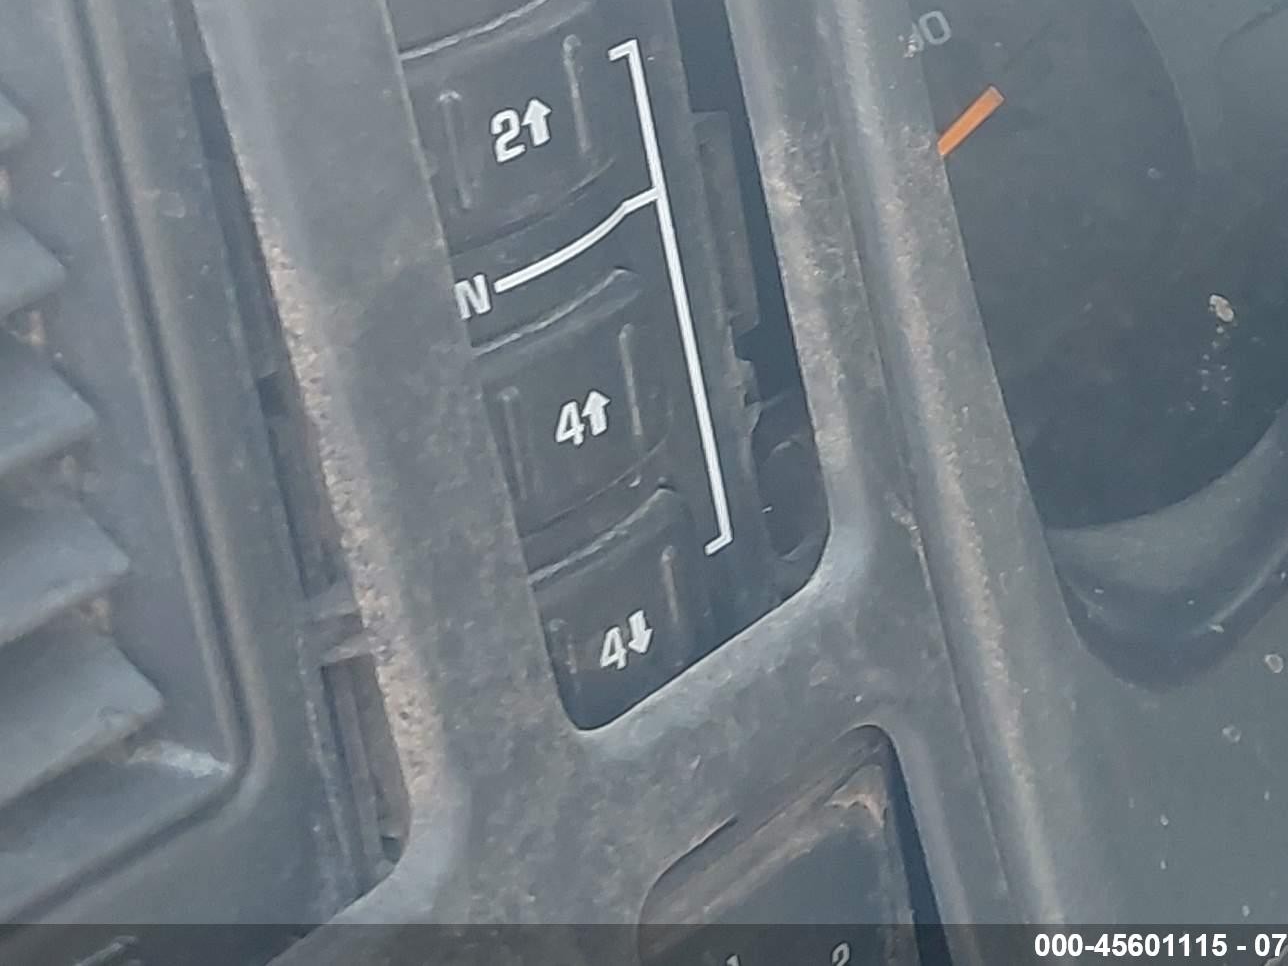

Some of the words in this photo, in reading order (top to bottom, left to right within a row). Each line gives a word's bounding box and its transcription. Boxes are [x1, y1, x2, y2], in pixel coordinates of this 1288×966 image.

[491, 111, 525, 163] 2
[454, 274, 492, 319] N
[555, 401, 584, 446] 4
[600, 627, 627, 670] 4
